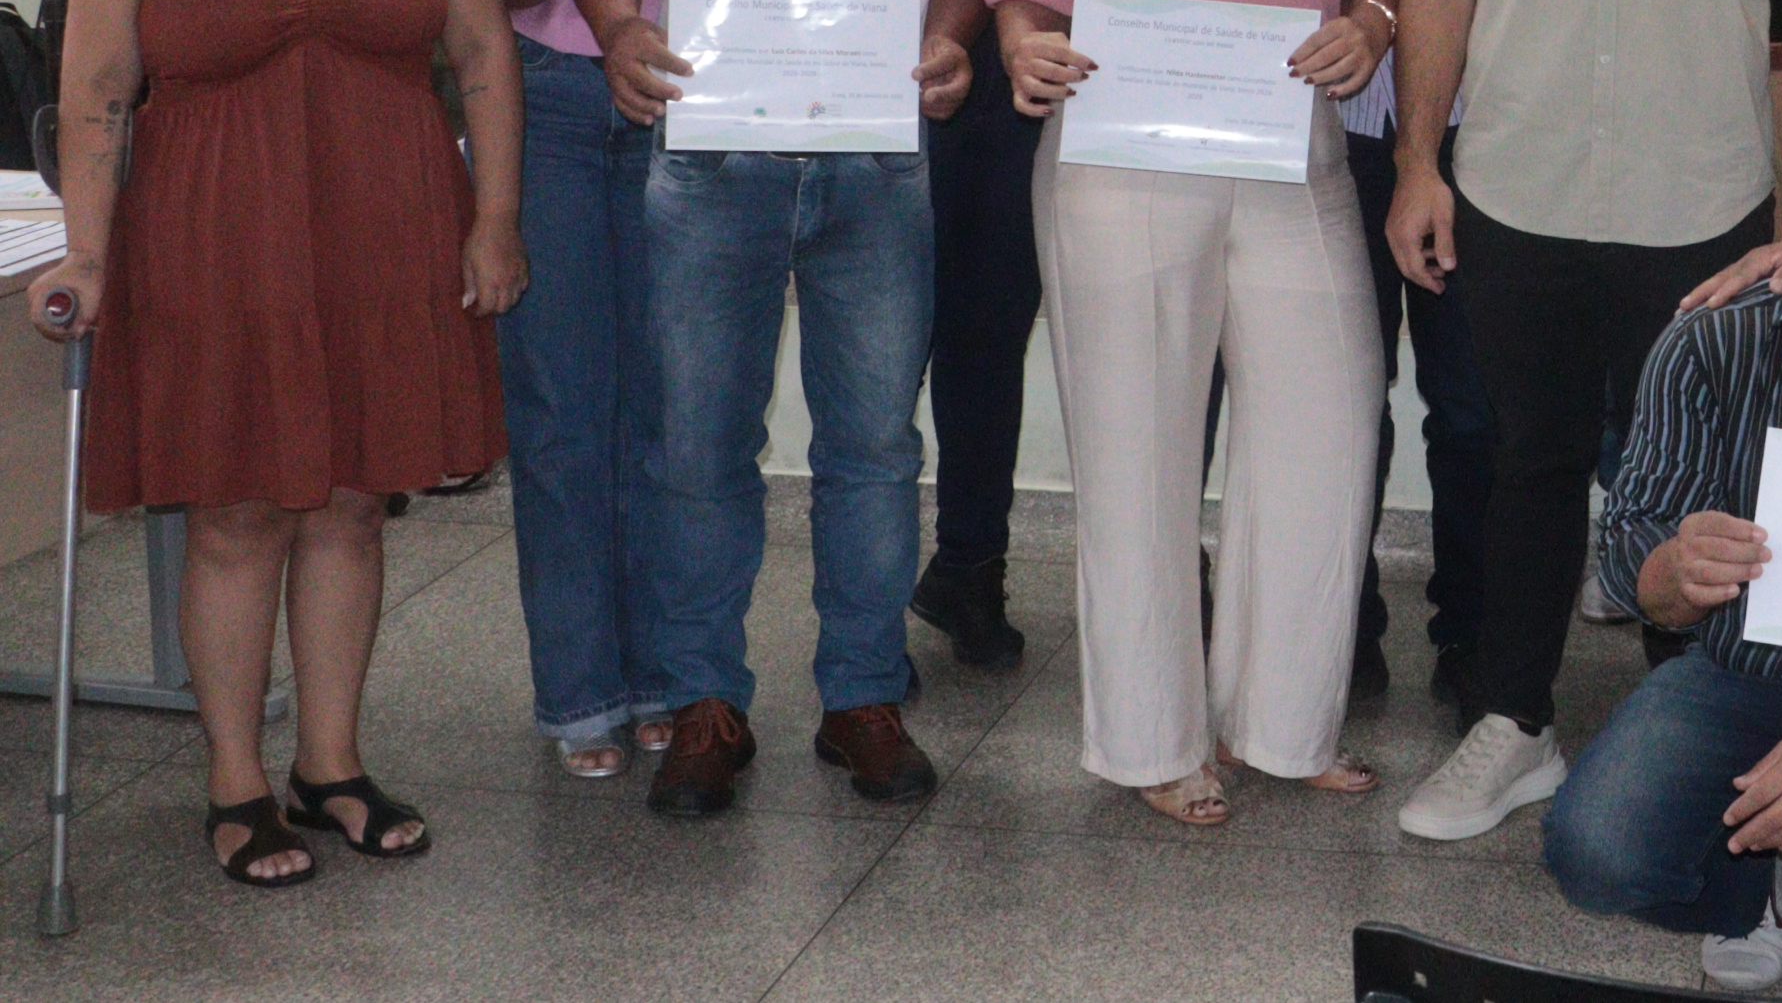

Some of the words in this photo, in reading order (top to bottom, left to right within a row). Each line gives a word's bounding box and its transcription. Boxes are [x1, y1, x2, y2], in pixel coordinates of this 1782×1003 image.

[846, 1, 858, 11] de
[861, 2, 887, 12] Viana
[1108, 16, 1150, 29] Conselho
[1152, 20, 1198, 36] Municipal
[1200, 25, 1212, 35] de
[1215, 25, 1244, 39] Saúde
[1245, 29, 1258, 40] de
[1260, 31, 1286, 43] Viana
